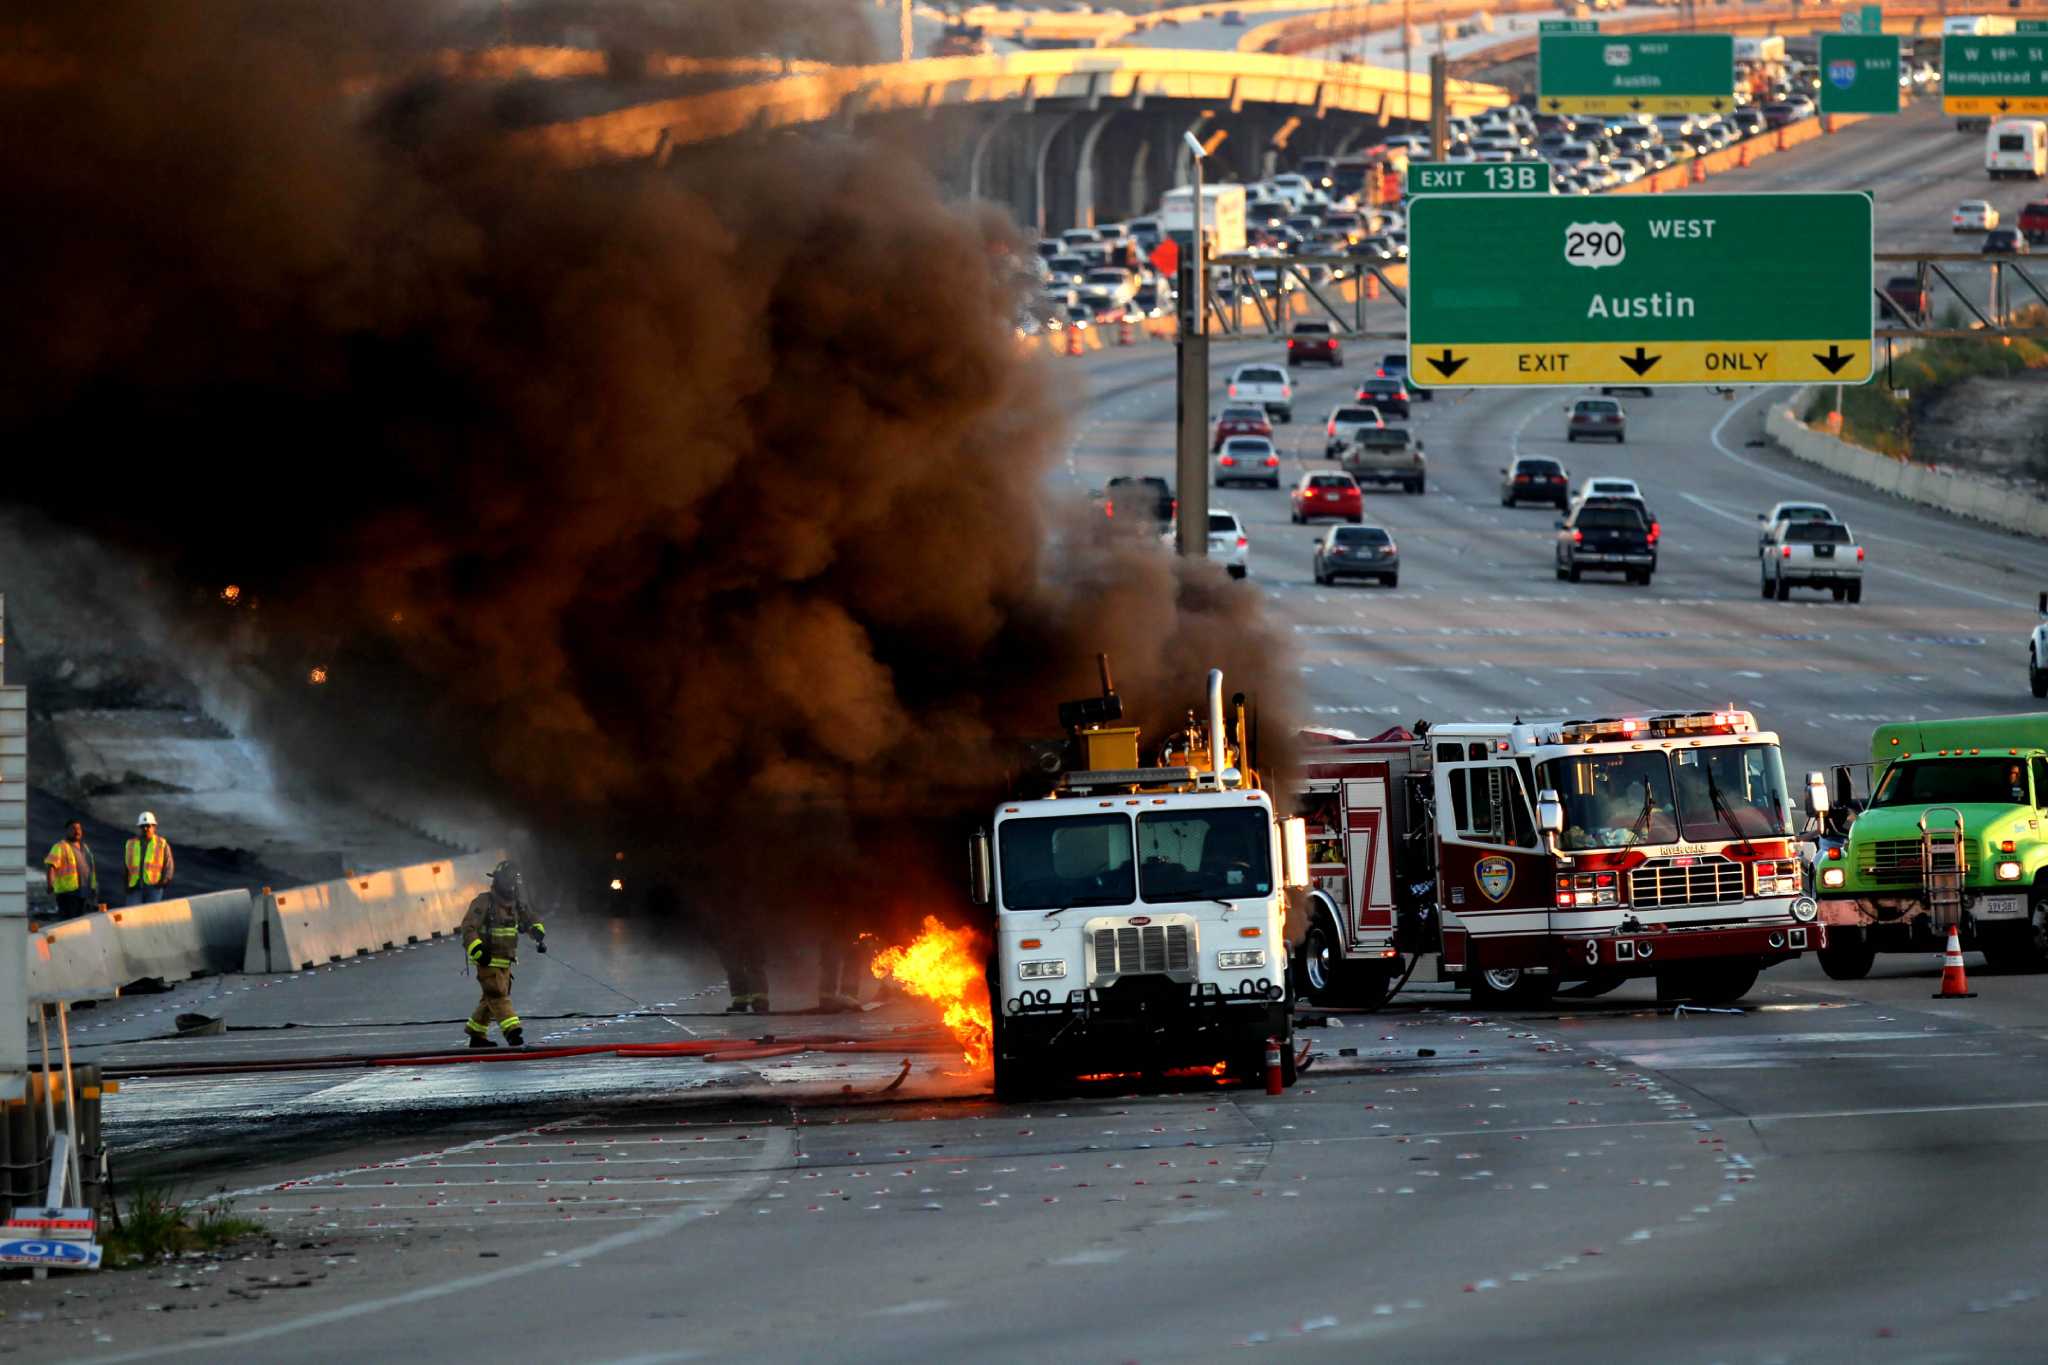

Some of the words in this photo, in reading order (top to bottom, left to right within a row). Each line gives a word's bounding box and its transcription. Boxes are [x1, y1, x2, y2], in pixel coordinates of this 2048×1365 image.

[1639, 44, 1669, 53] WEST
[1964, 47, 1980, 61] W
[2028, 47, 2043, 61] St
[1864, 58, 1892, 69] EAST
[1613, 75, 1662, 87] Austin
[1947, 71, 2031, 85] Hempstead
[1421, 170, 1466, 187] EXIT
[1484, 167, 1537, 190] 13B
[1567, 231, 1623, 257] 290
[1648, 219, 1717, 239] WEST
[1587, 291, 1695, 318] Austin
[1518, 354, 1570, 372] EXIT
[1704, 352, 1768, 370] ONLY
[1820, 923, 1828, 949] 3
[1585, 939, 1598, 965] 3
